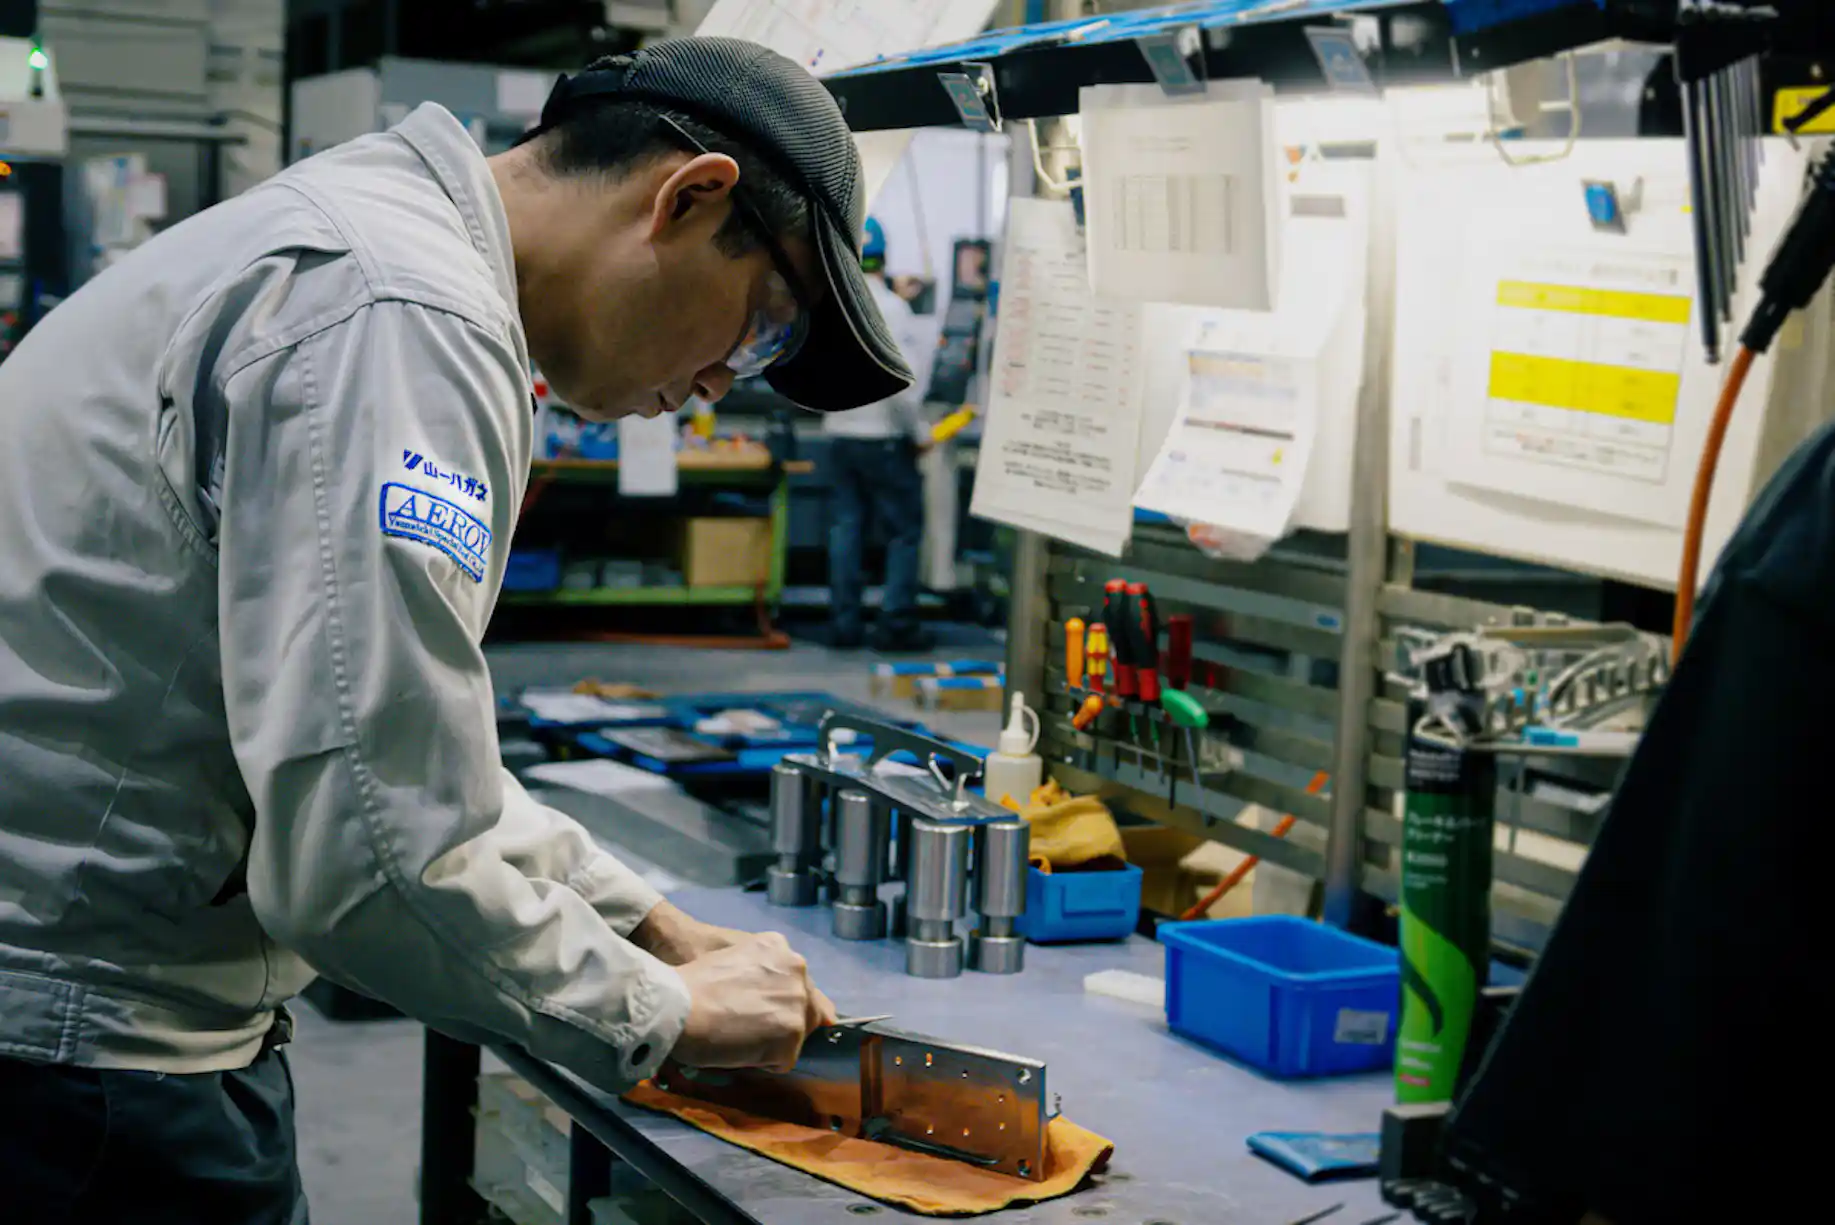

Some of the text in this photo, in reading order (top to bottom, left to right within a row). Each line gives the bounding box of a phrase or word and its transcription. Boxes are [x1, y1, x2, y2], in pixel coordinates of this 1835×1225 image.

[423, 461, 488, 501] 山一ハガネ
